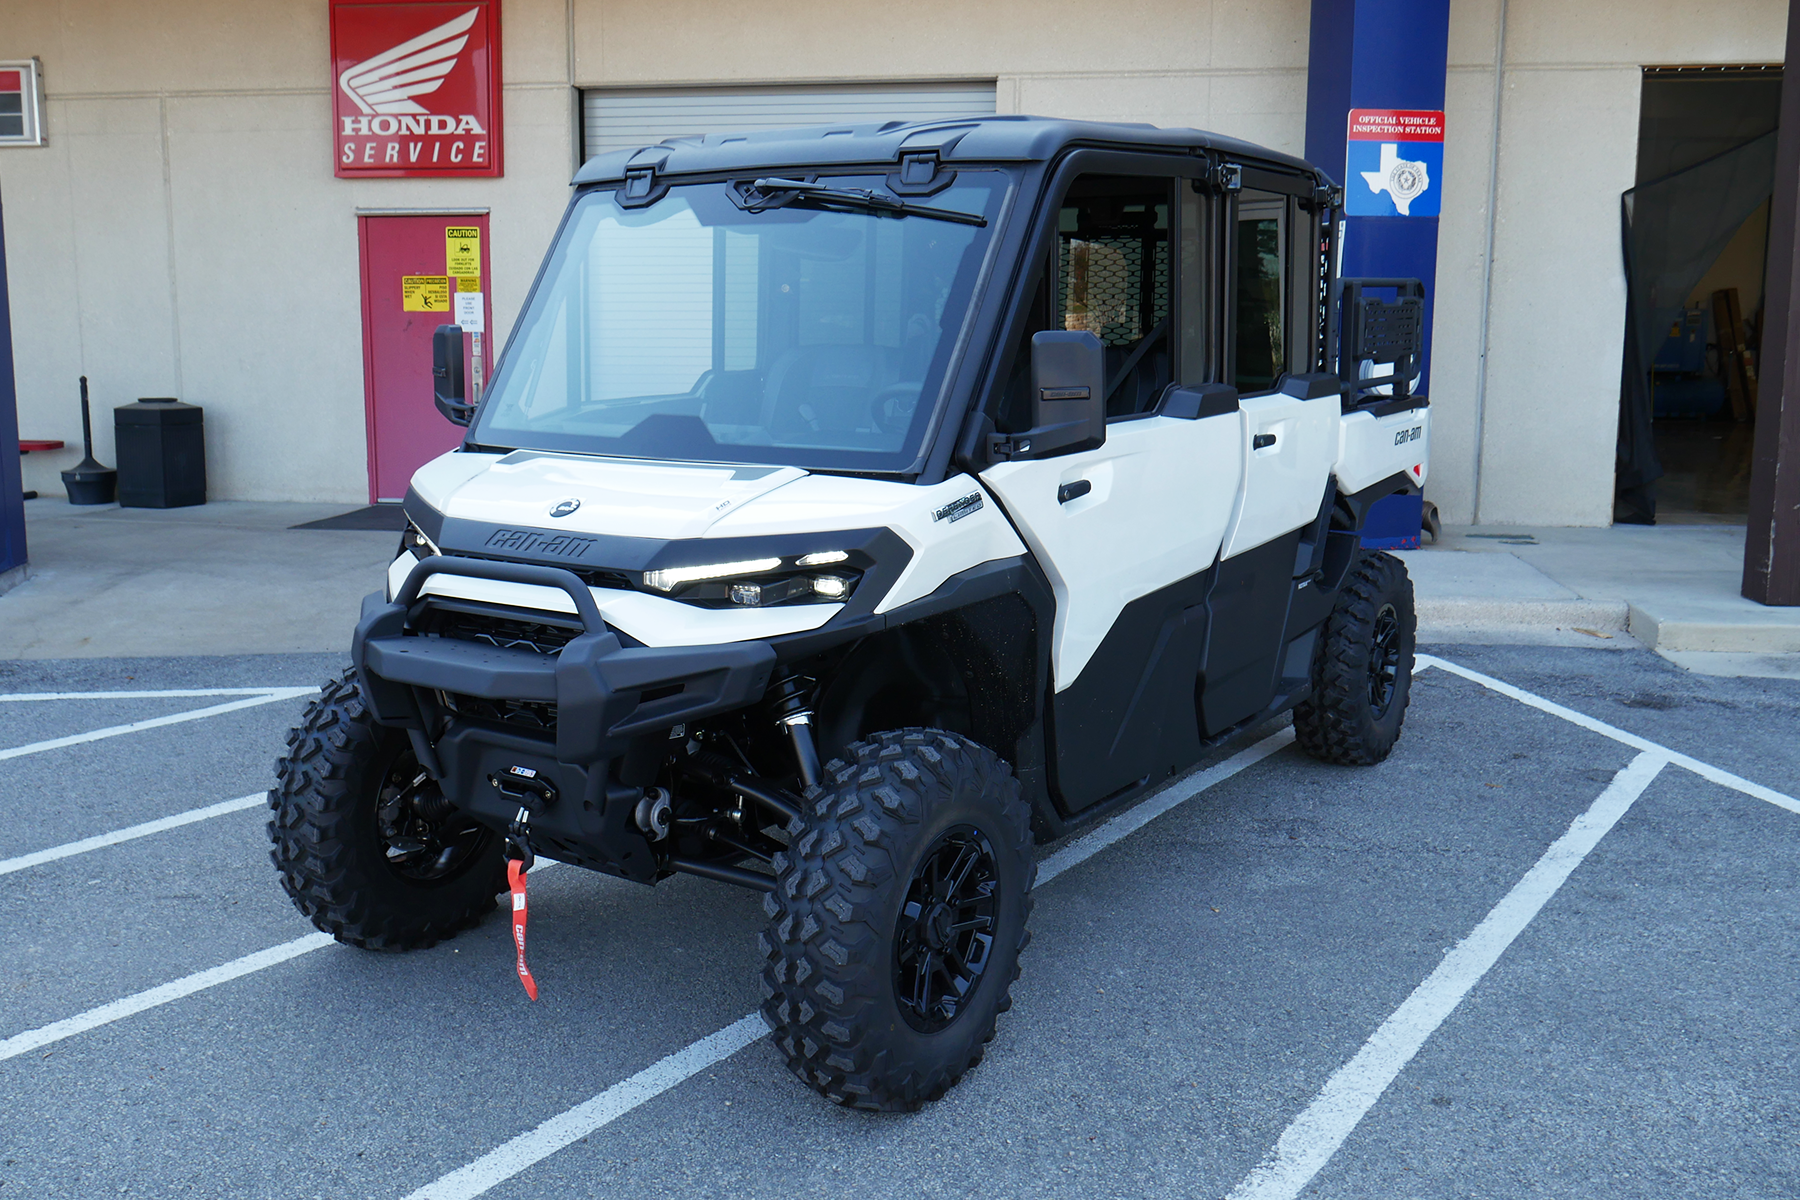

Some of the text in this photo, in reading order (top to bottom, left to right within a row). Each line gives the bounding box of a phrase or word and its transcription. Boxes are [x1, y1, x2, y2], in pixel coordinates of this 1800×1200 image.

[341, 114, 486, 136] HONDA
[1352, 125, 1442, 135] INSPECTION STATION
[1358, 115, 1437, 125] OFFICIAL VEHICLE
[342, 141, 486, 163] SERVICE
[448, 229, 477, 237] CAUTION
[1394, 425, 1422, 446] can-am
[484, 528, 598, 558] can-am
